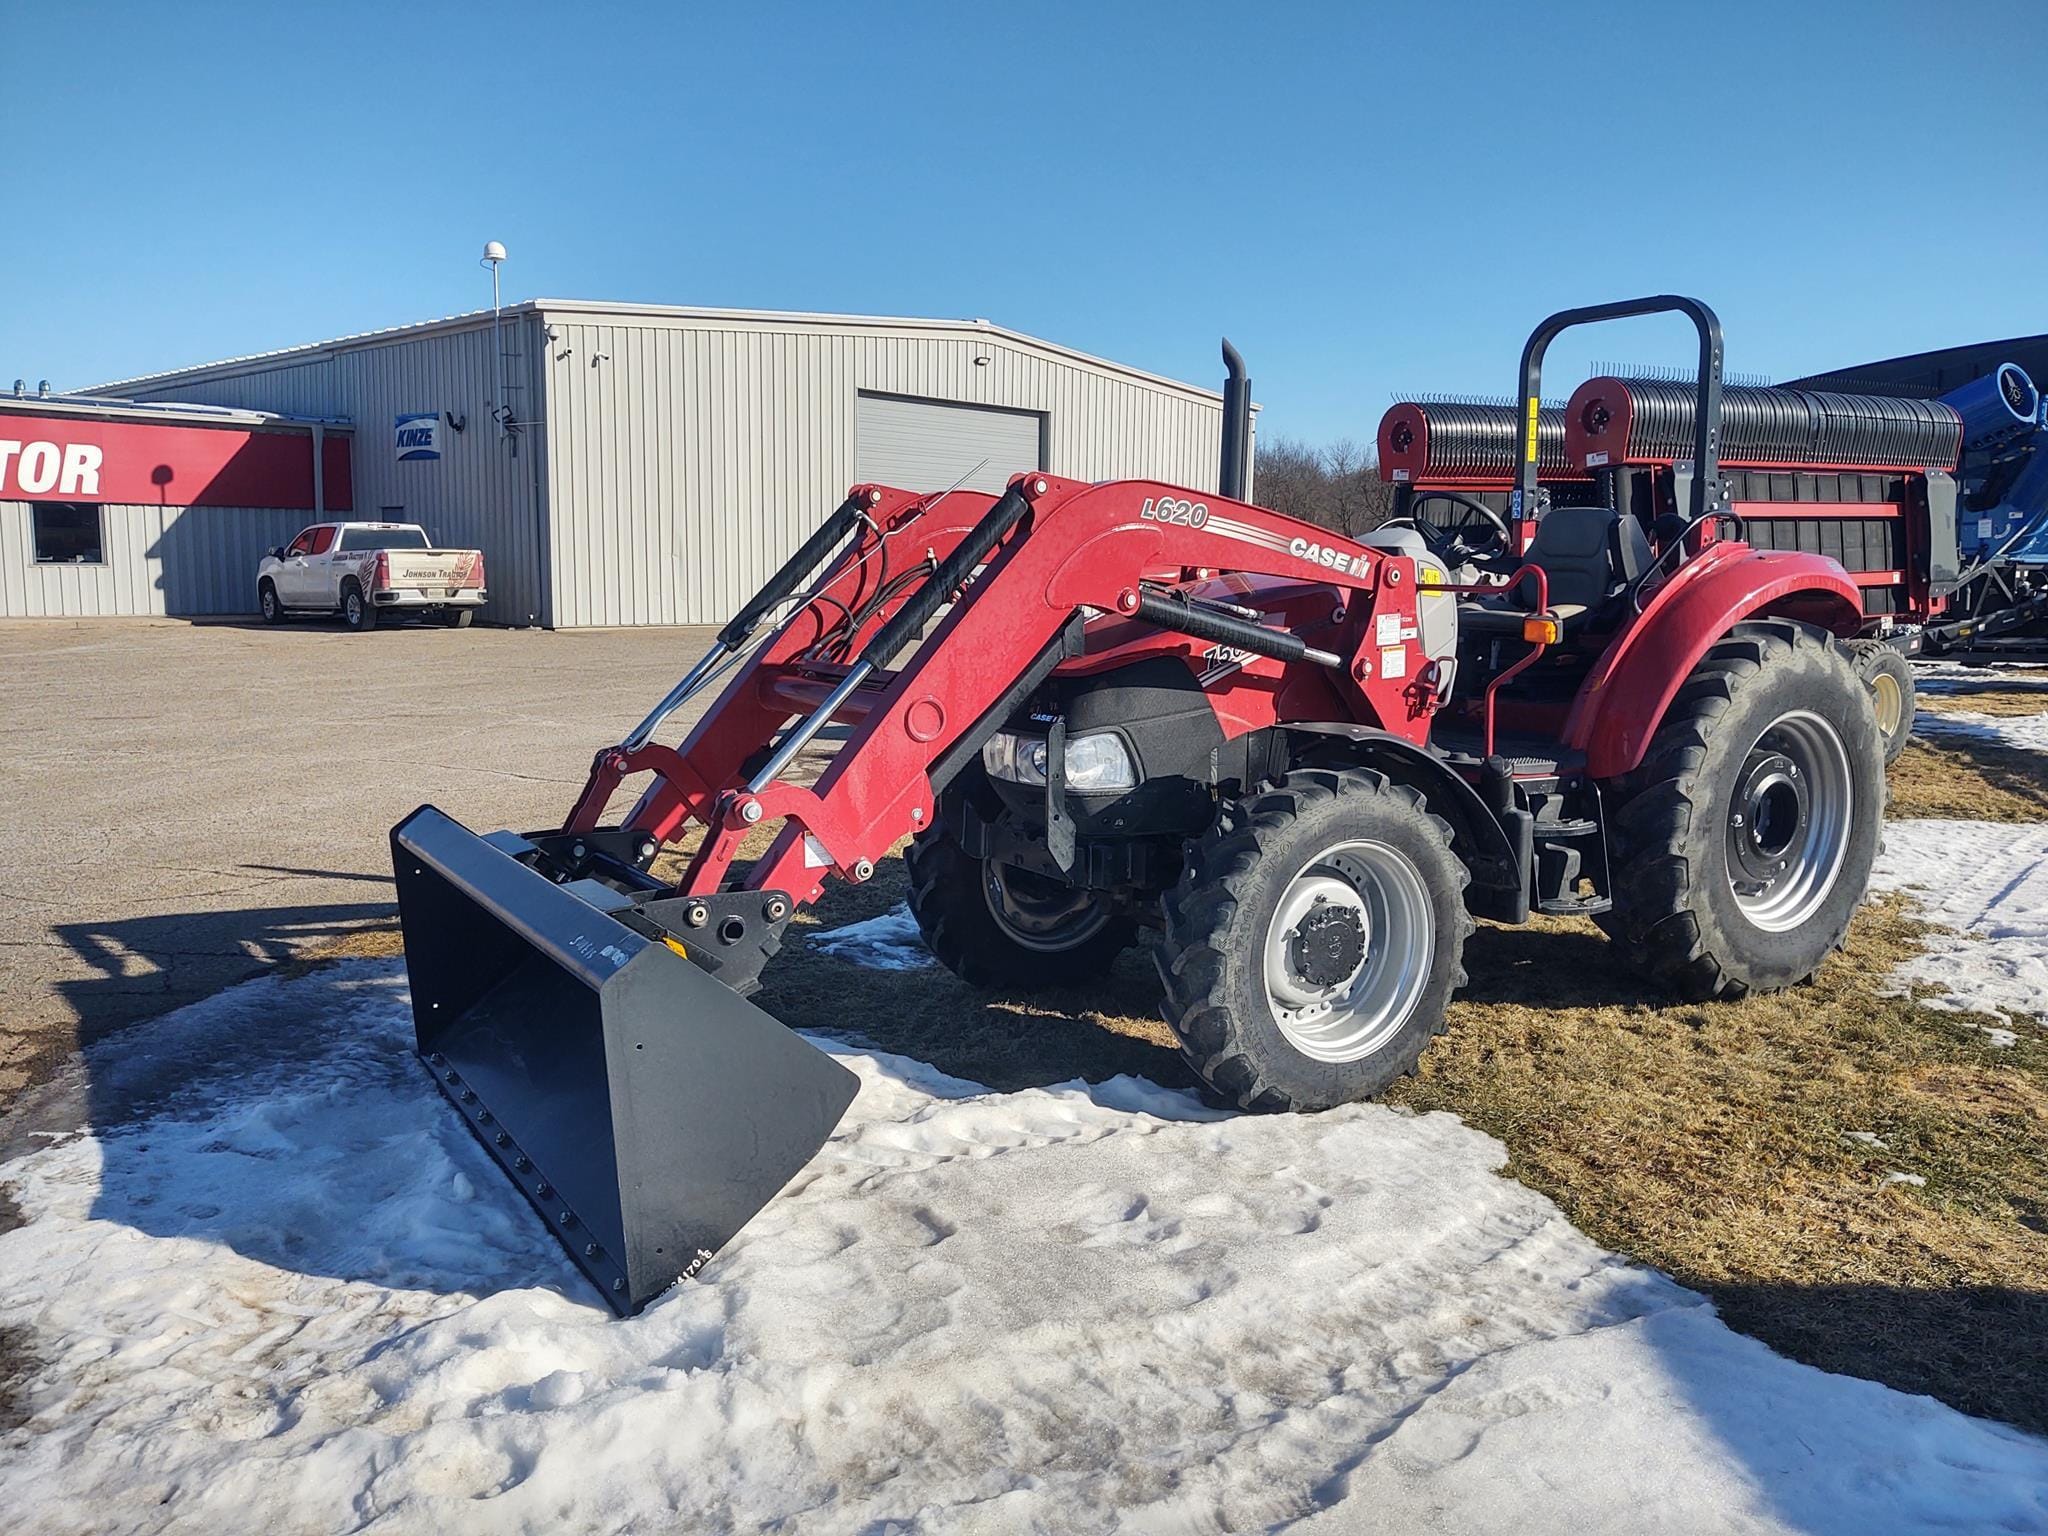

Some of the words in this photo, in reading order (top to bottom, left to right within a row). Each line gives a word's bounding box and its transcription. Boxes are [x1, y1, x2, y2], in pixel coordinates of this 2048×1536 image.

[396, 428, 433, 448] KINZE
[1140, 496, 1209, 528] L620
[1289, 537, 1351, 573] CASE
[1030, 713, 1053, 722] CASE
